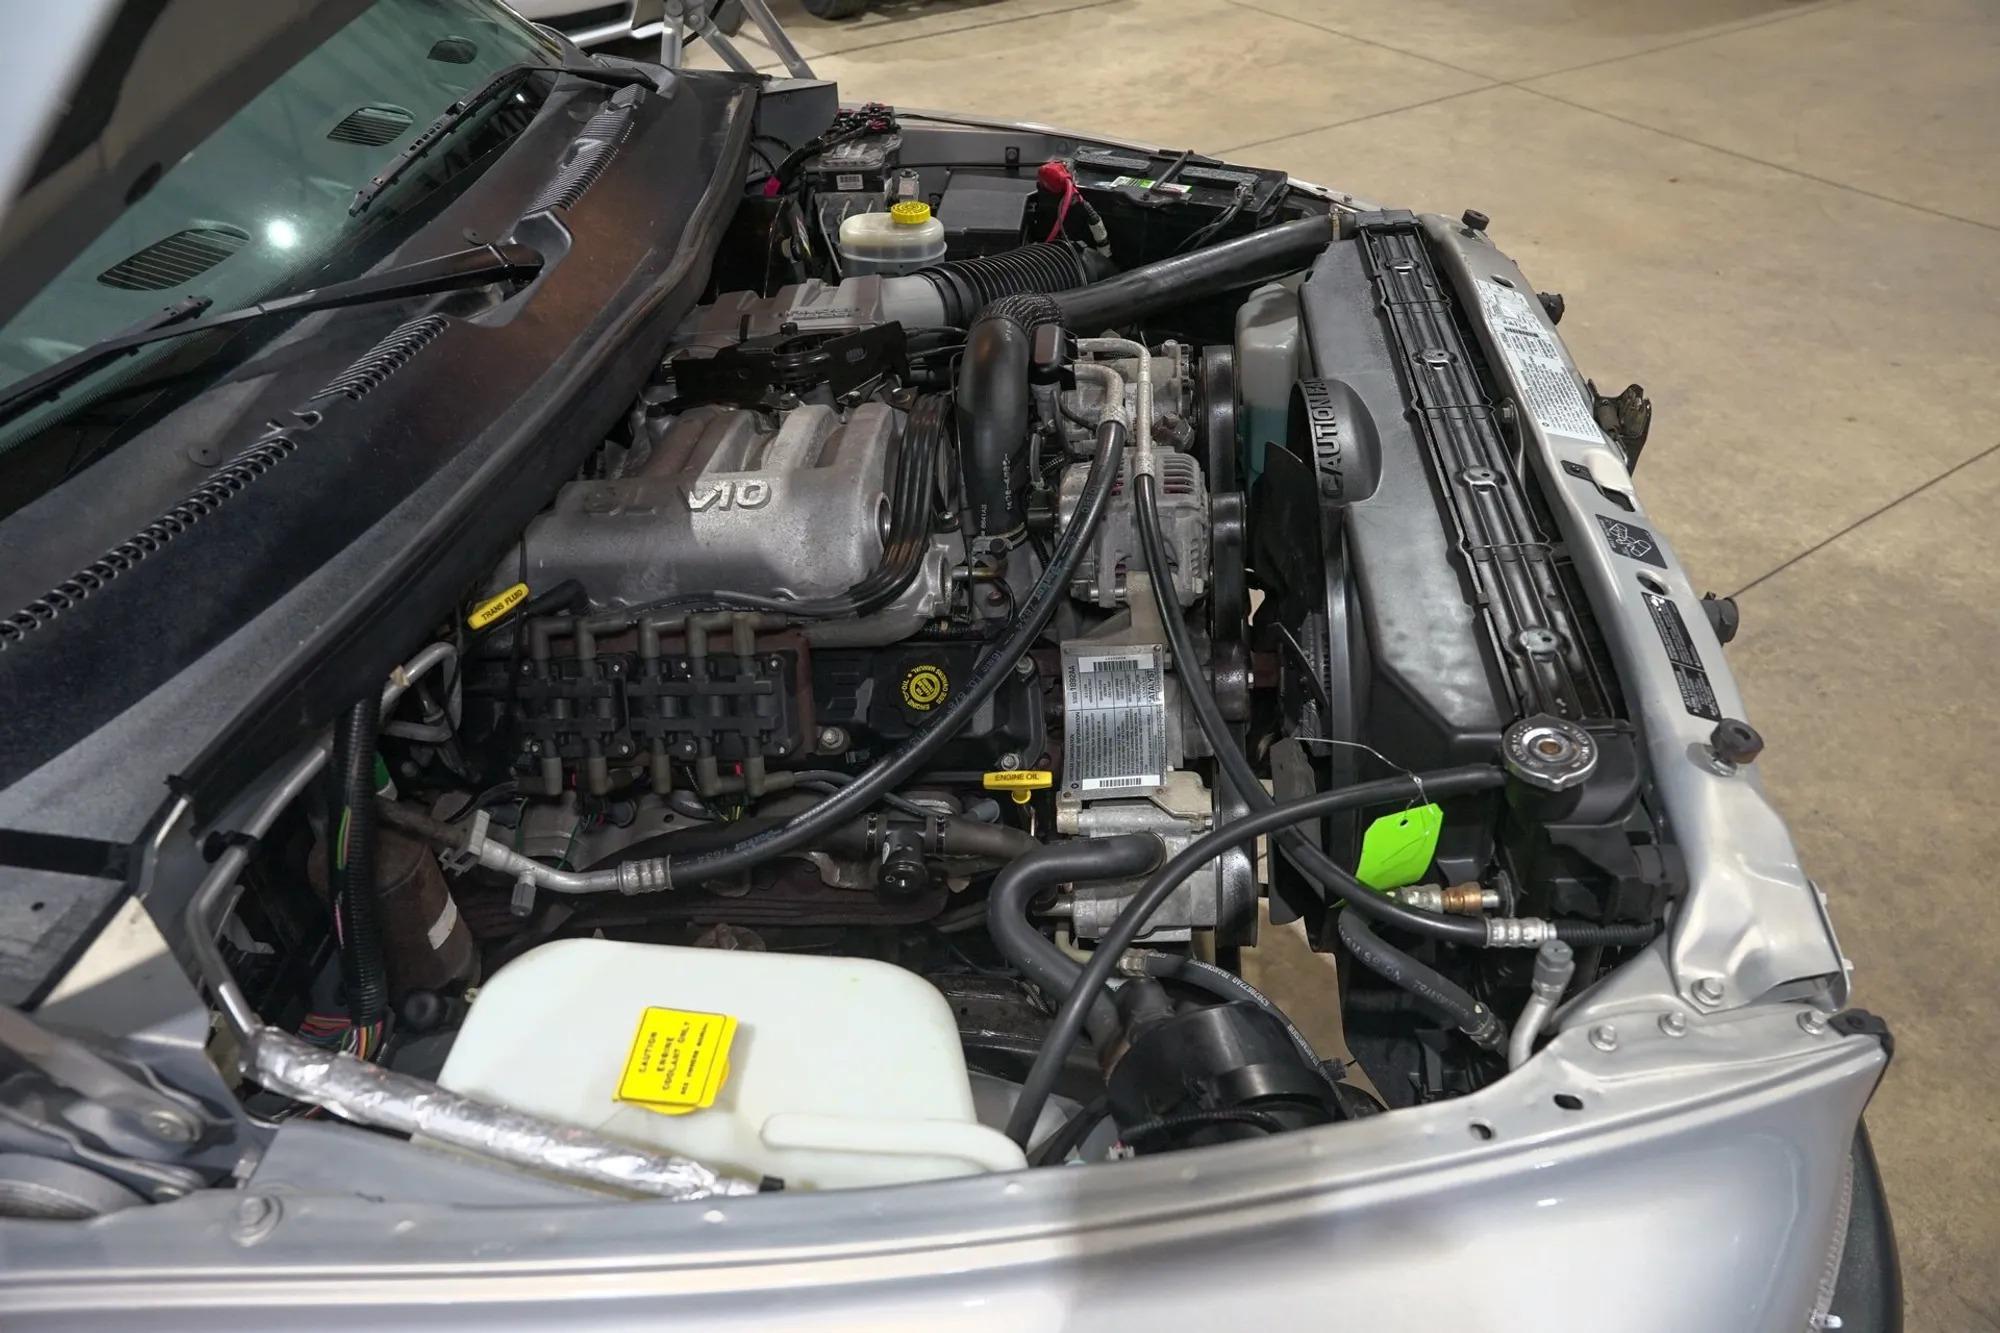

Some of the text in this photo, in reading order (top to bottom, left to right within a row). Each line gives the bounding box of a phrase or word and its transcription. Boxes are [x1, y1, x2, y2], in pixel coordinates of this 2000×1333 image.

[1309, 398, 1343, 498] CAUTION
[677, 480, 772, 512] V10
[481, 589, 523, 620] TRANS FLUID
[638, 1031, 658, 1073] CAUTION
[657, 1037, 675, 1072] ENGINE
[662, 1048, 680, 1090] COOLANT
